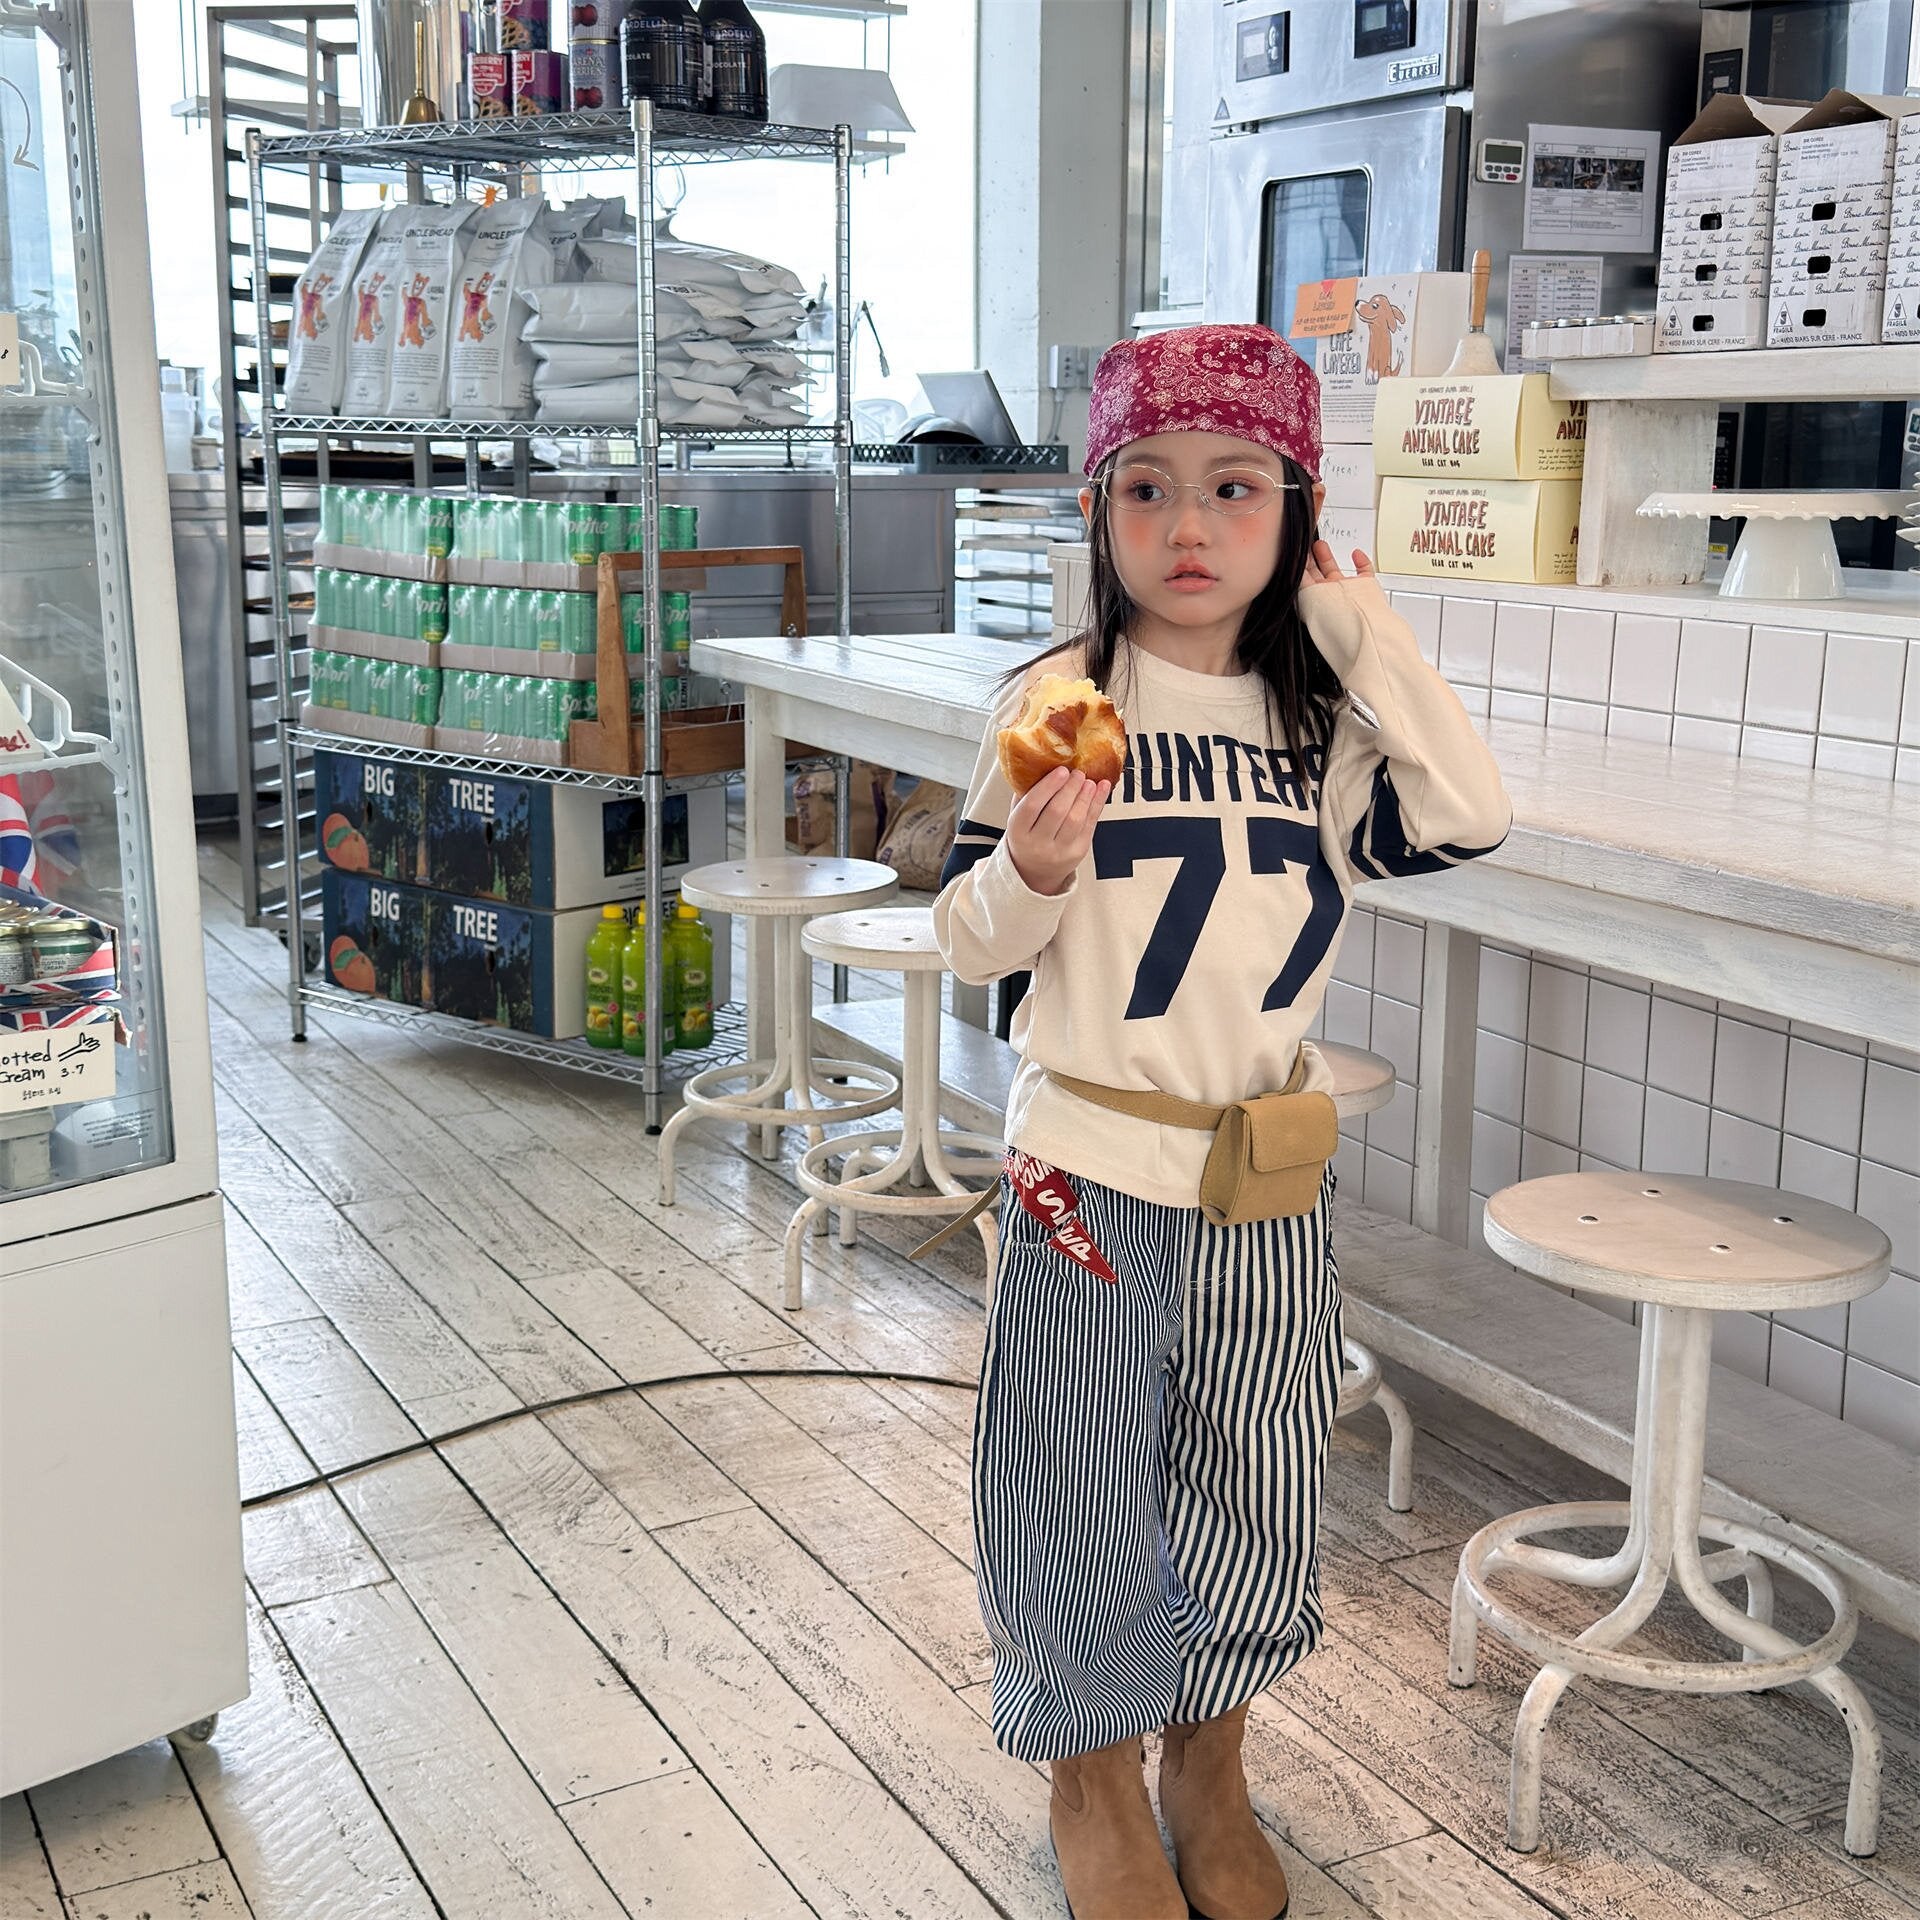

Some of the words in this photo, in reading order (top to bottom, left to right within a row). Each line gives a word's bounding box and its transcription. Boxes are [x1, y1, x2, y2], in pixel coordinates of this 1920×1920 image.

[1415, 397, 1475, 426] VINTAGE
[1402, 427, 1451, 455] ANIMAL
[1453, 428, 1480, 455] CAKE
[1424, 500, 1489, 529] VINTAGE
[1410, 528, 1463, 556] ANIMAL
[1466, 531, 1495, 558] CAKE
[364, 764, 395, 797] BIG
[449, 778, 495, 814] TREE
[370, 887, 400, 921] BIG
[453, 904, 498, 942] TREE
[1093, 816, 1345, 1020] 77
[0, 1039, 52, 1067] otted
